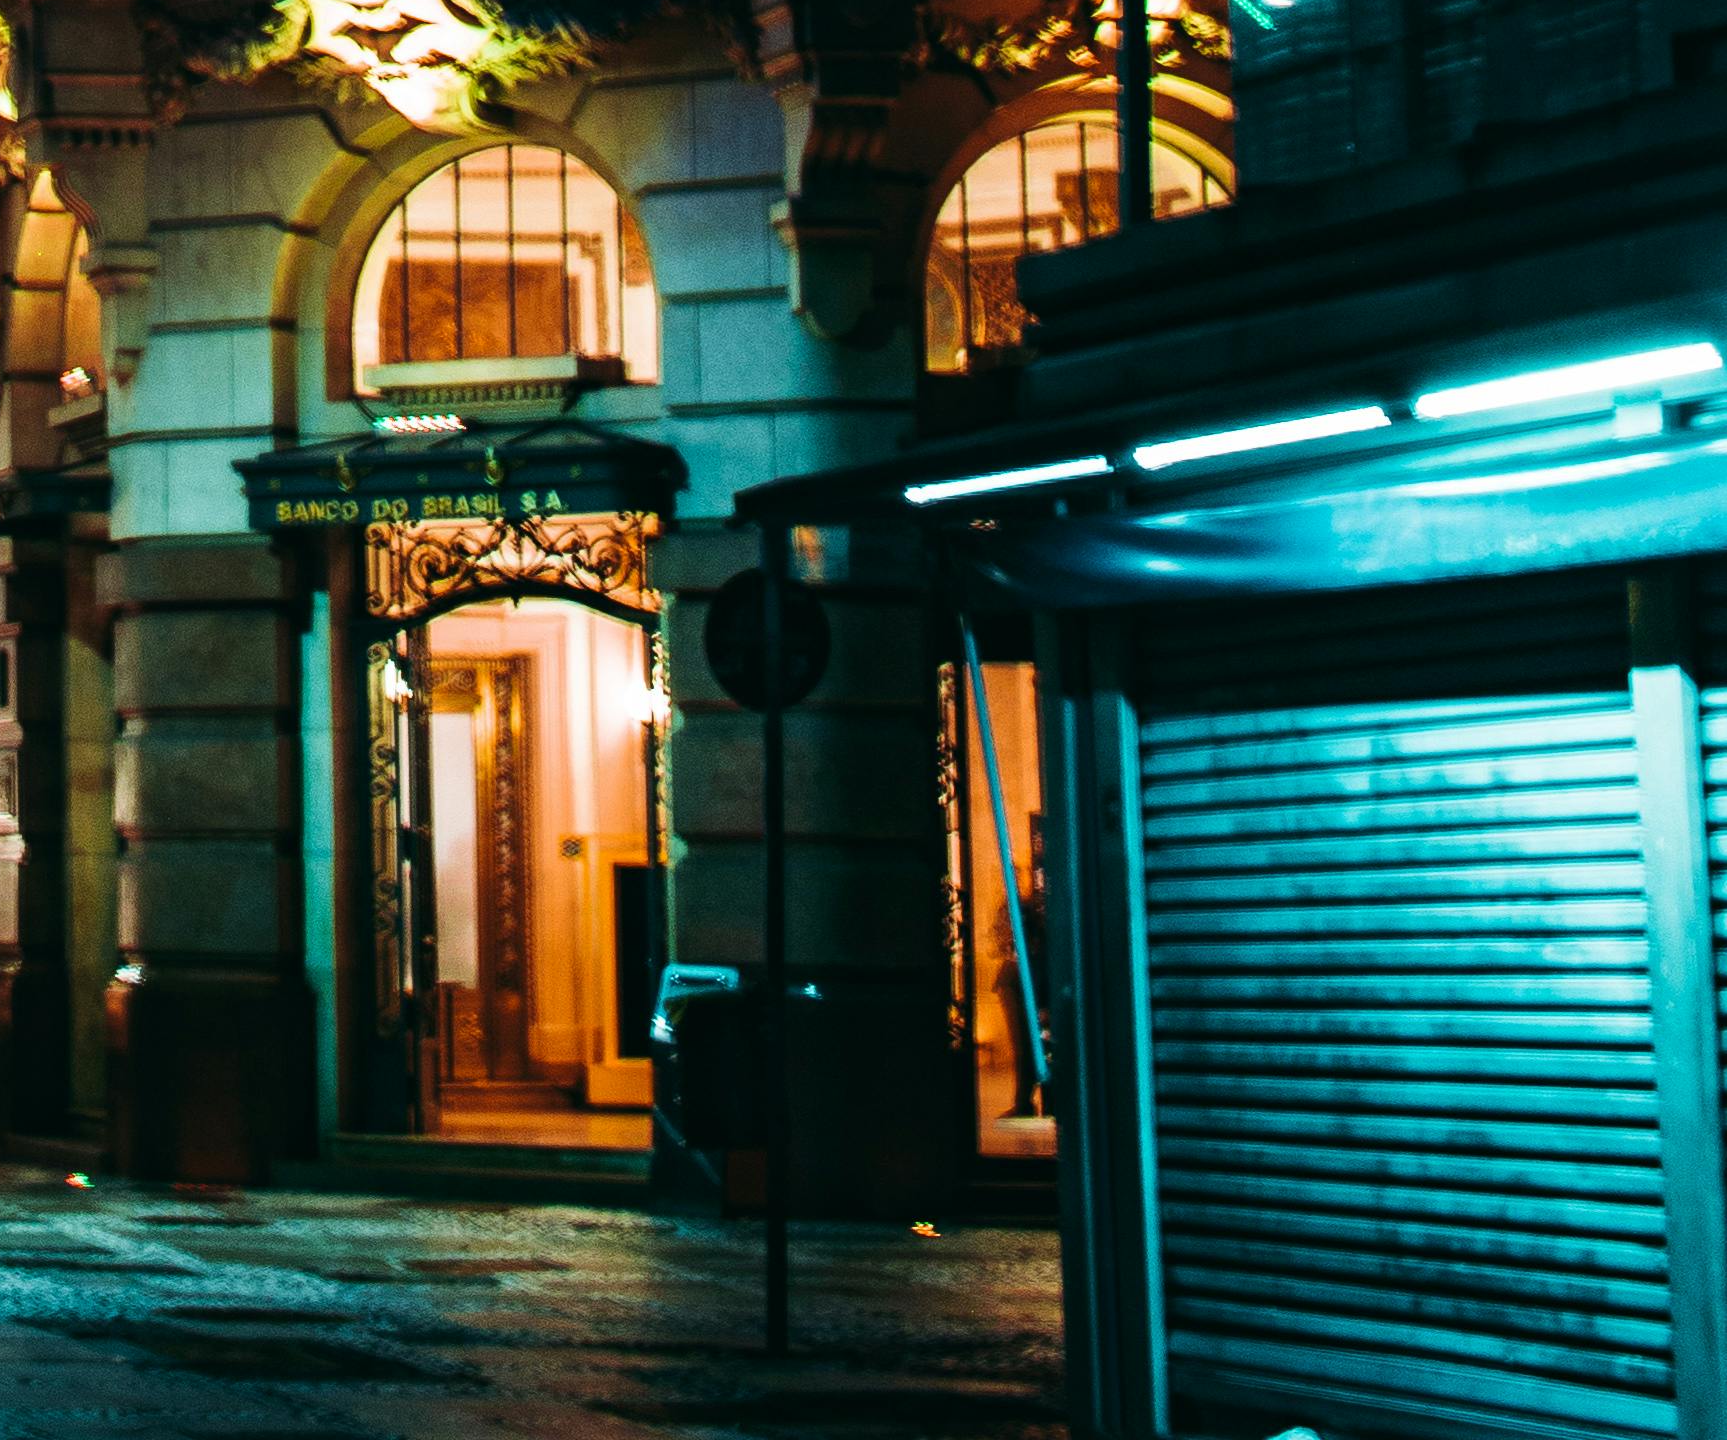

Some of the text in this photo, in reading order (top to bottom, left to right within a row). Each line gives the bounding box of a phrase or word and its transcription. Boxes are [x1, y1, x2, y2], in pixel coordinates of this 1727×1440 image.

[275, 499, 359, 523] BANCO
[371, 497, 409, 521] DO
[421, 492, 503, 517] BRASIL
